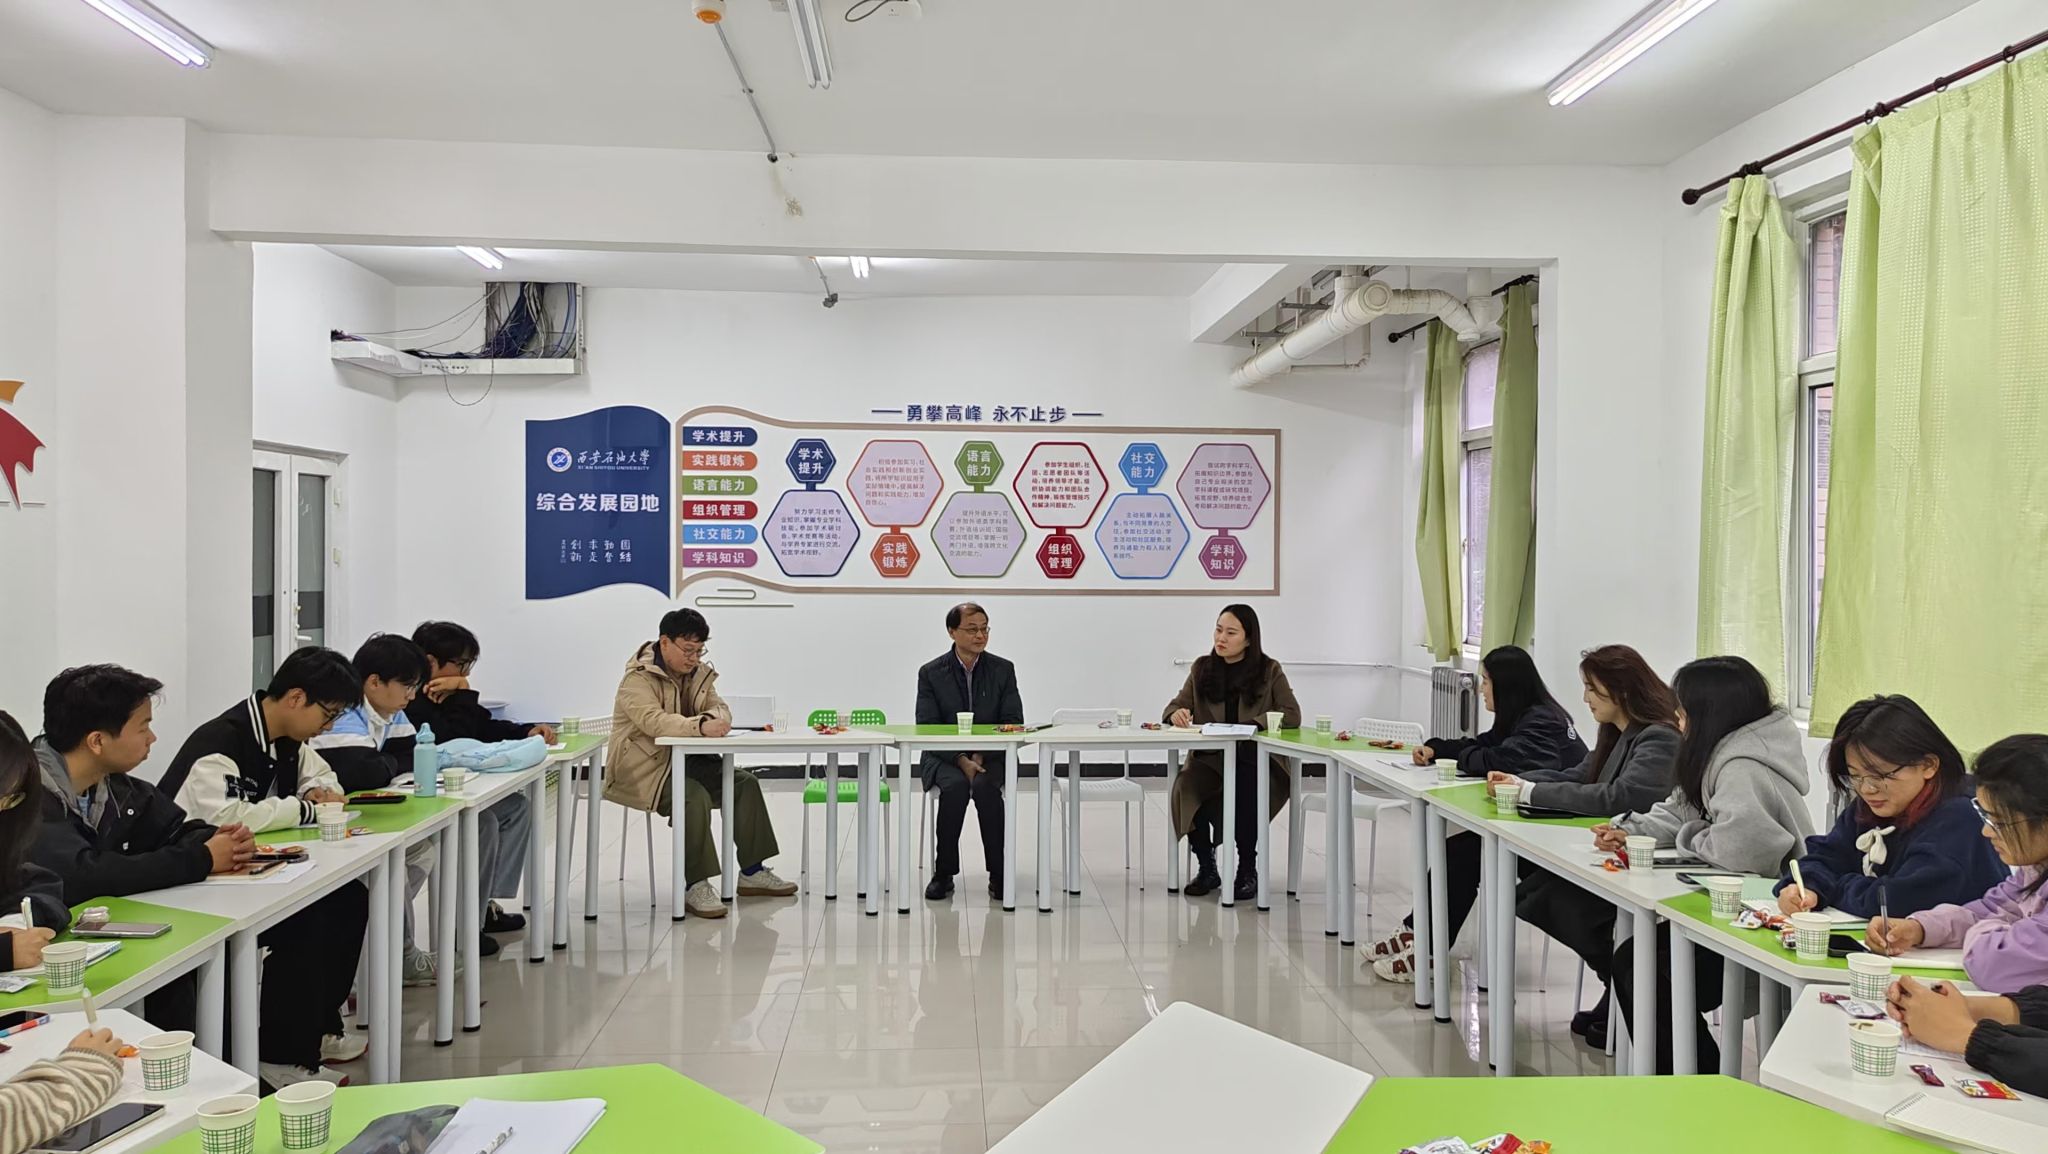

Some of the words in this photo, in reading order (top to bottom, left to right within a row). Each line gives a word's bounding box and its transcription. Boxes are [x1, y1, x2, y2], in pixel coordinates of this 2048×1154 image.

[906, 404, 982, 422] 勇攀高峰
[993, 406, 1066, 423] 永不止步
[692, 430, 745, 443] 学术提升
[798, 448, 824, 460] 学术
[967, 451, 992, 463] 语言
[1130, 452, 1155, 465] 社交
[692, 454, 745, 467] 实践锻炼
[798, 462, 824, 475] 提升
[967, 465, 991, 477] 能力
[1131, 467, 1155, 479] 能力
[692, 479, 745, 492] 语言能力
[536, 492, 660, 512] 综合发展园地
[692, 504, 746, 516] 组织管理
[692, 528, 746, 541] 社交能力
[882, 542, 908, 554] 实践
[1048, 544, 1072, 556] 组织
[1210, 544, 1234, 557] 学科
[692, 552, 745, 564] 学科知识
[882, 556, 908, 568] 锻炼
[1048, 557, 1072, 569] 管理
[1210, 558, 1235, 571] 知识
